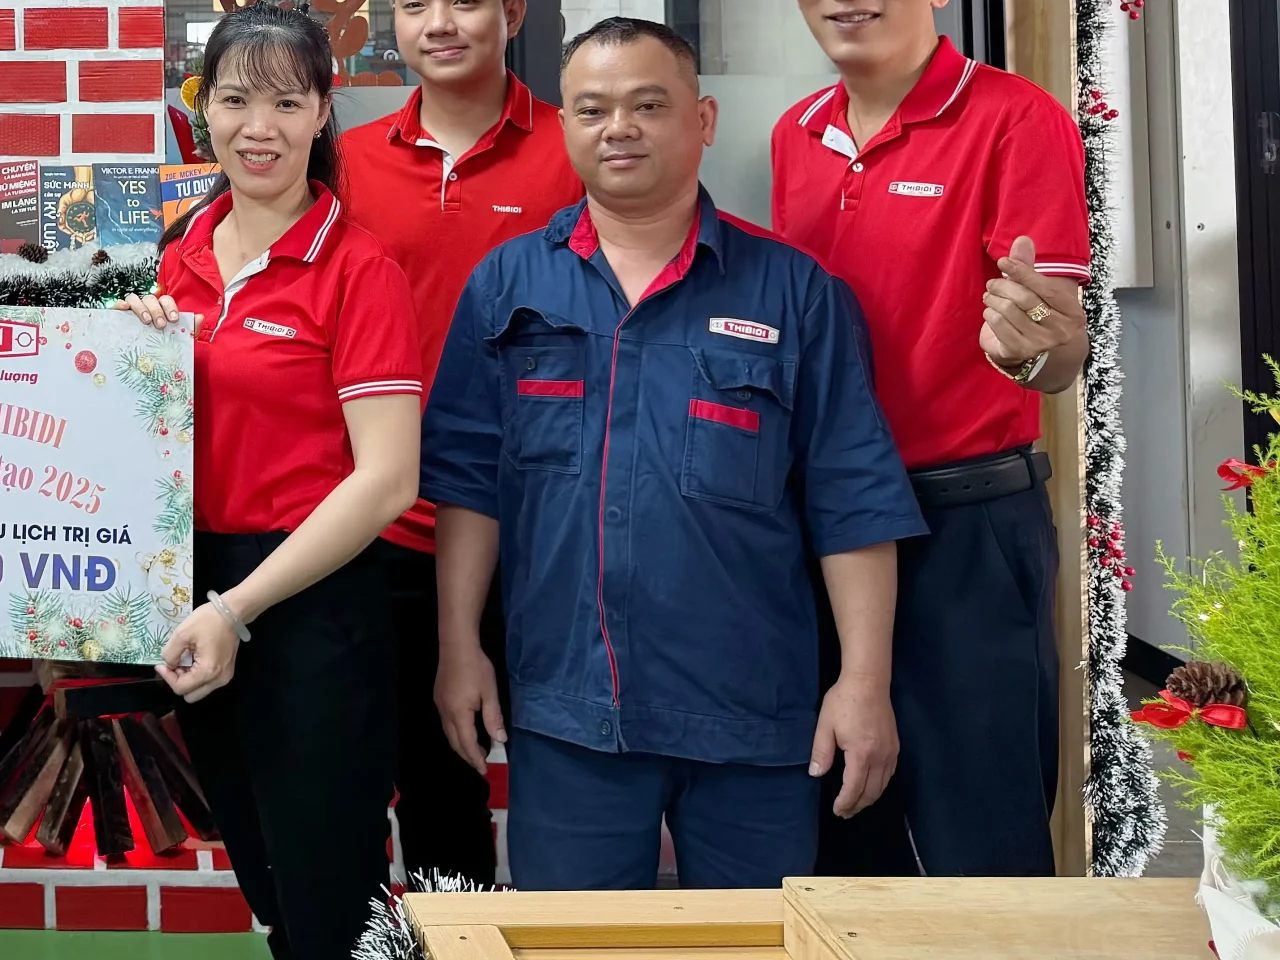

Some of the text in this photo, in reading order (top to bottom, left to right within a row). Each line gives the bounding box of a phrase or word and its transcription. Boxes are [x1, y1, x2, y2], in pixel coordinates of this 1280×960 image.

[101, 167, 128, 175] VIKTOR
[165, 168, 202, 181] ZOE MCKEY
[44, 180, 62, 189] SỨC
[118, 180, 147, 195] YES
[192, 177, 216, 195] DUY
[1, 201, 12, 210] IM
[127, 198, 140, 207] to
[492, 205, 522, 214] THIBIDI
[119, 210, 151, 225] LIFE
[727, 322, 767, 338] THIBIDI
[0, 370, 39, 385] lượng
[38, 465, 107, 515] 2025
[12, 524, 57, 545] LỊCH
[62, 526, 90, 548] TRỊ
[96, 524, 133, 545] GIÁ
[19, 551, 117, 592] VNĐ
